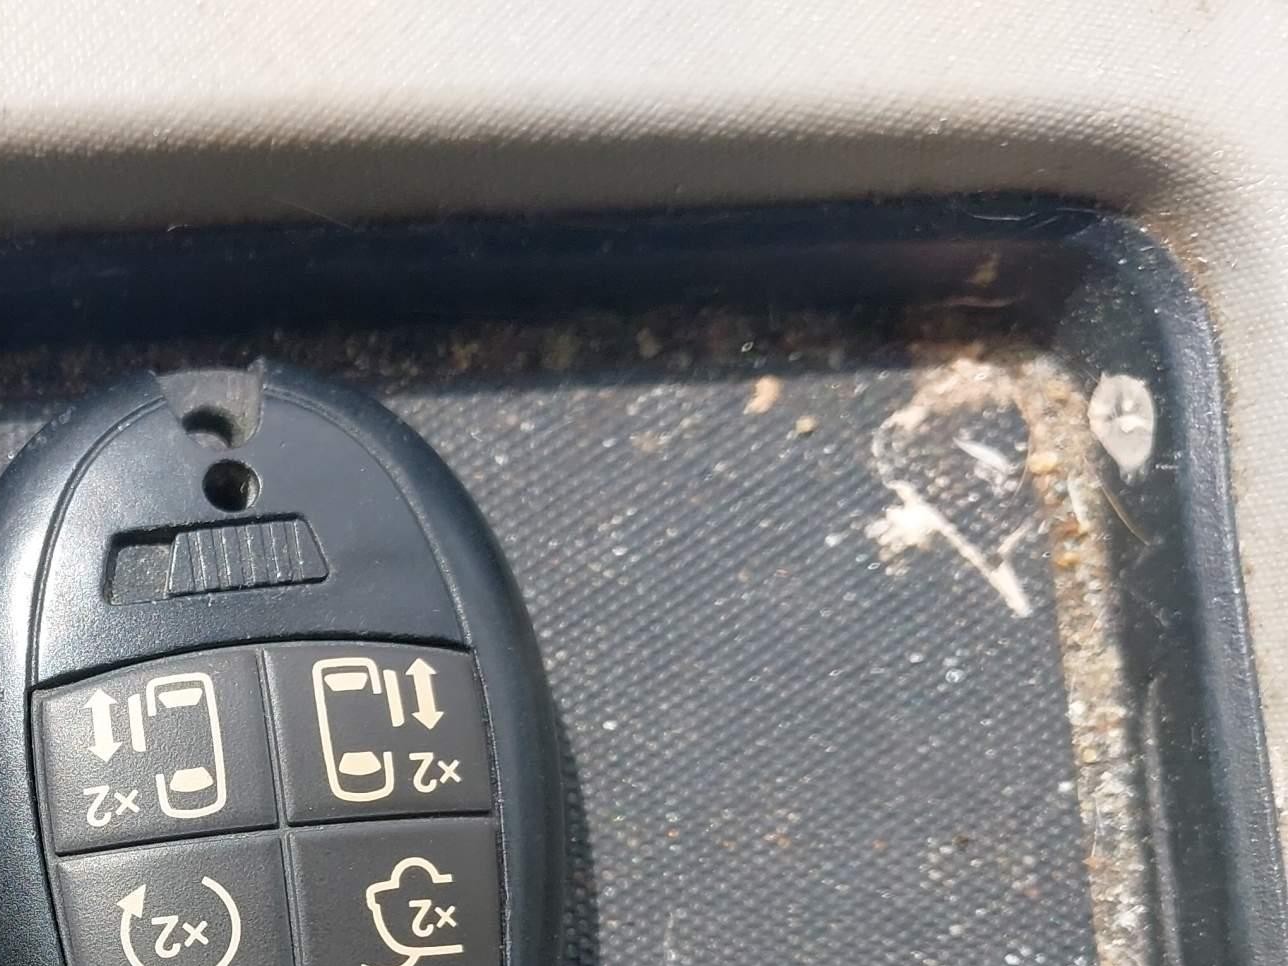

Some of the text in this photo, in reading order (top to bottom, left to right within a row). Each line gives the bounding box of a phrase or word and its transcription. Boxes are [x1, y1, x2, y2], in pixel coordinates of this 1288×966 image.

[409, 752, 463, 792] x2
[83, 786, 141, 828] x2
[150, 914, 208, 957] x2
[409, 900, 457, 937] x2
